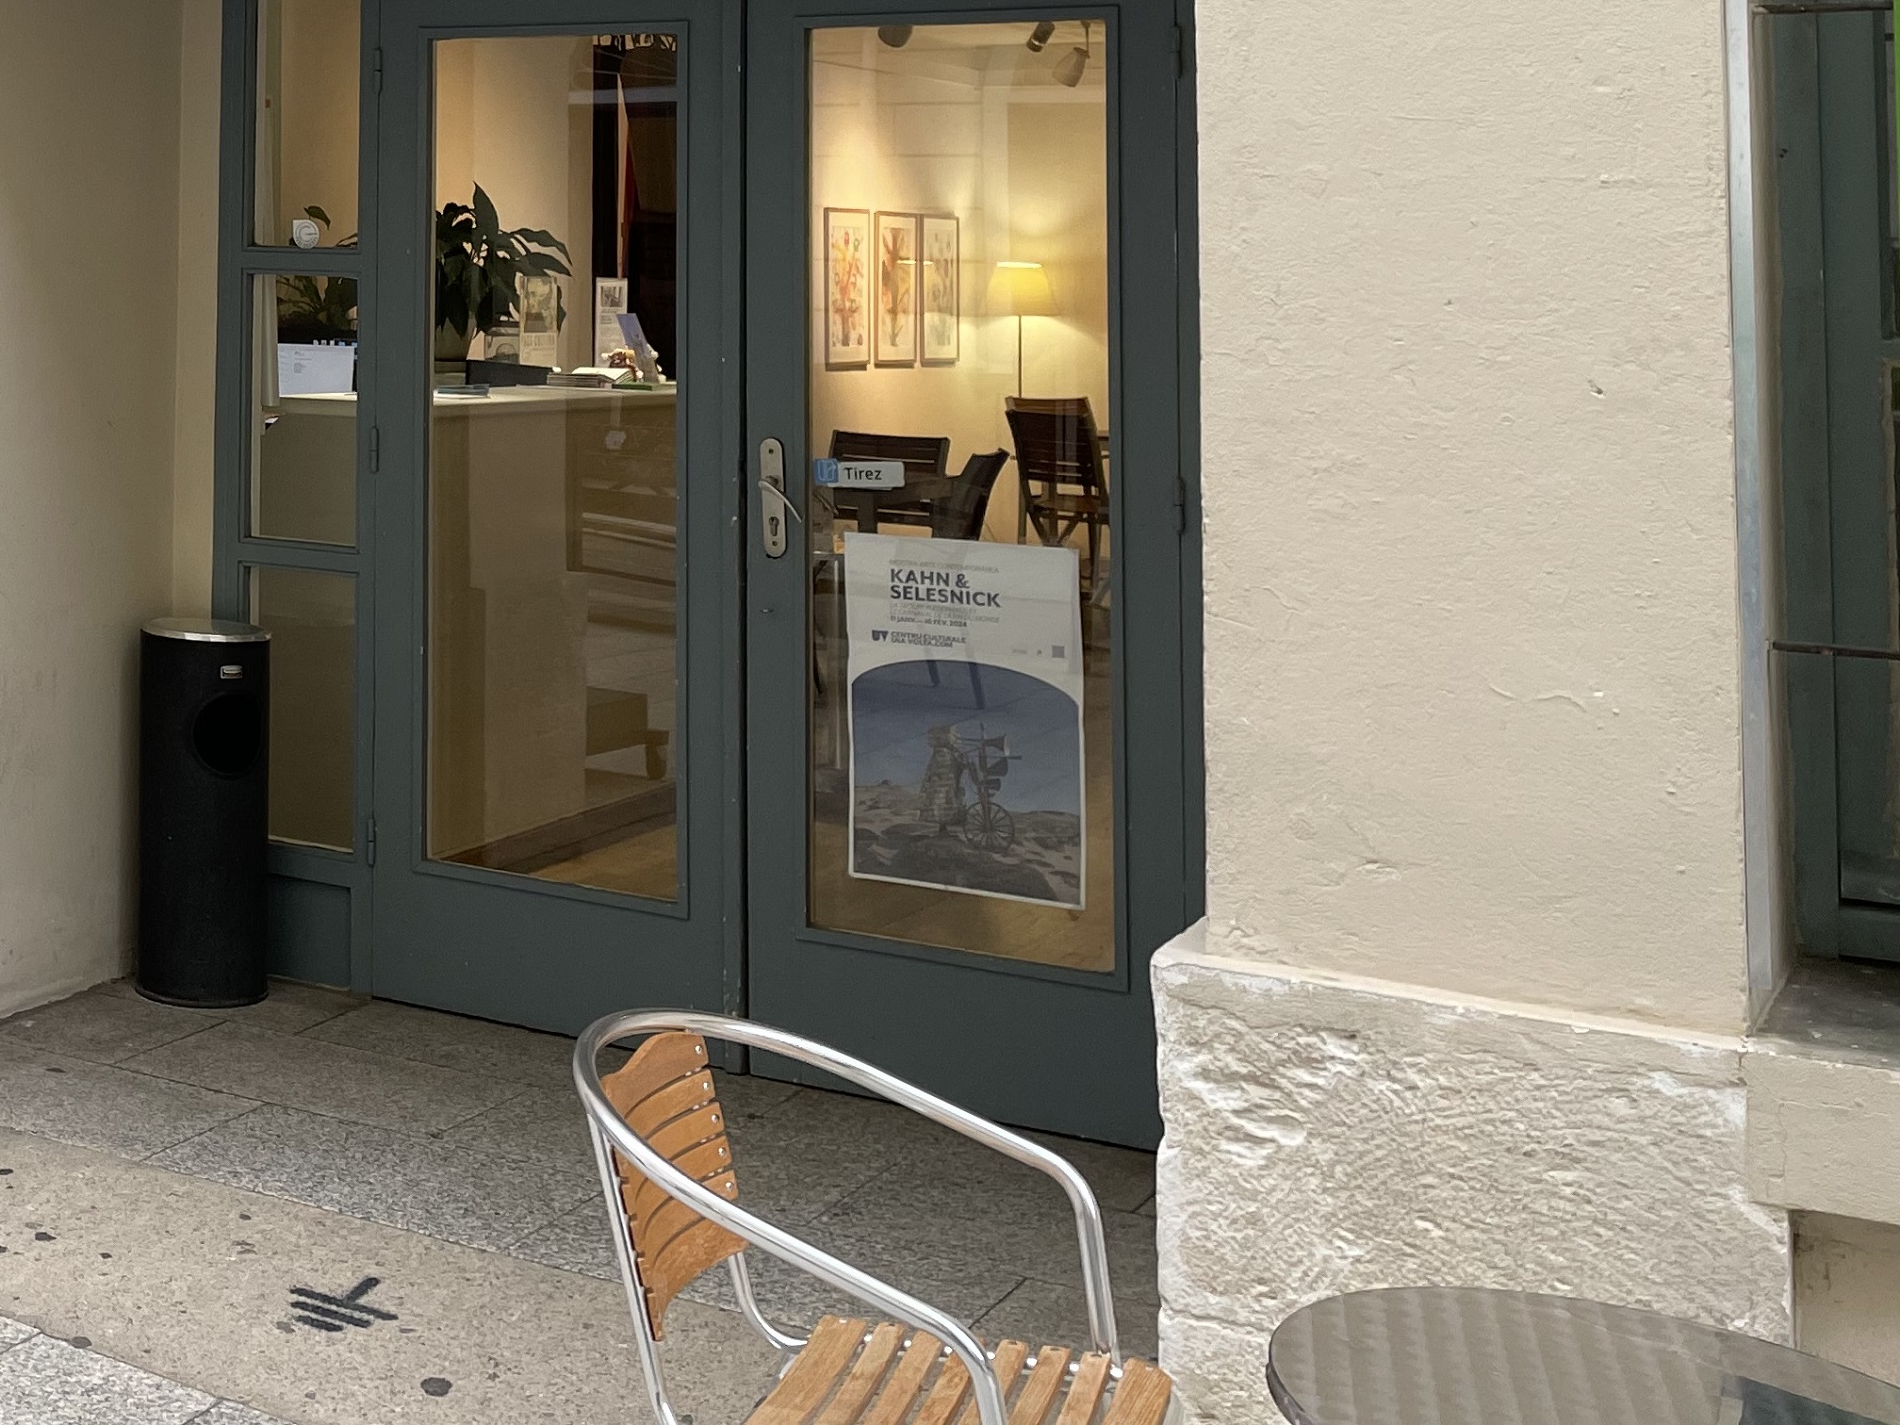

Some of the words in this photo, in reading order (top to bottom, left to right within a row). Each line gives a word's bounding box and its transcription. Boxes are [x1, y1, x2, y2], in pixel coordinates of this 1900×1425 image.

[843, 466, 883, 481] Tirez
[890, 568, 950, 587] KAHN
[955, 573, 970, 589] &
[890, 584, 1001, 608] SELESNICK
